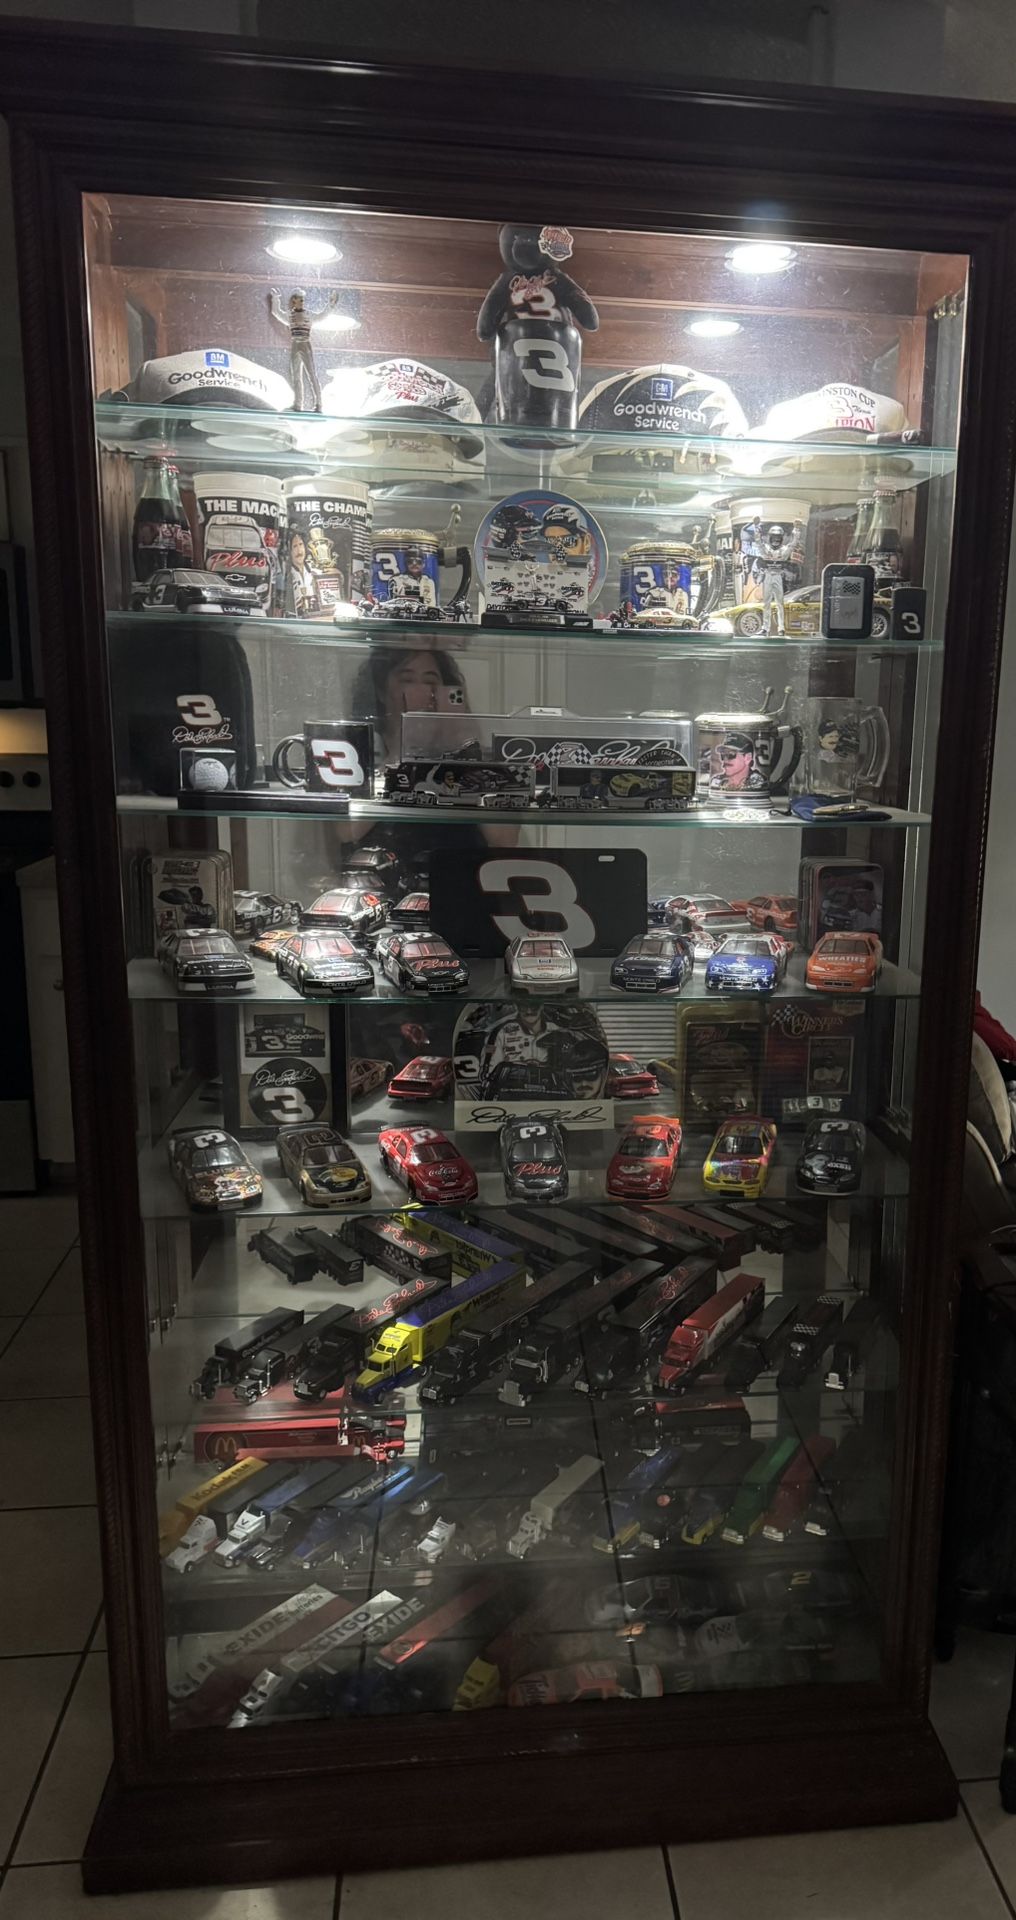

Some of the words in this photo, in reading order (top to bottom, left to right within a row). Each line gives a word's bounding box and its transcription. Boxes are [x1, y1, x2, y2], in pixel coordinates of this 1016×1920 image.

[511, 286, 561, 322] 3
[514, 339, 575, 392] 3
[858, 393, 876, 408] CUP
[613, 402, 706, 424] Goodwrench
[634, 416, 680, 430] Service
[204, 500, 238, 512] THE
[294, 501, 320, 511] THE
[208, 551, 267, 572] Plus
[375, 553, 400, 581] 3
[634, 566, 657, 595] 3
[902, 612, 921, 634] 3
[176, 694, 223, 726] 3
[311, 739, 365, 786] 3
[397, 773, 409, 784] 3
[479, 859, 596, 949] 3
[415, 959, 460, 972] Plus
[261, 1036, 284, 1050] 3
[453, 1055, 479, 1078] 3
[263, 1087, 315, 1122] 3
[511, 1161, 562, 1178] Plus
[790, 1571, 812, 1585] 2
[365, 1597, 426, 1642] EXIDE
[224, 1612, 289, 1655] EXIDE
